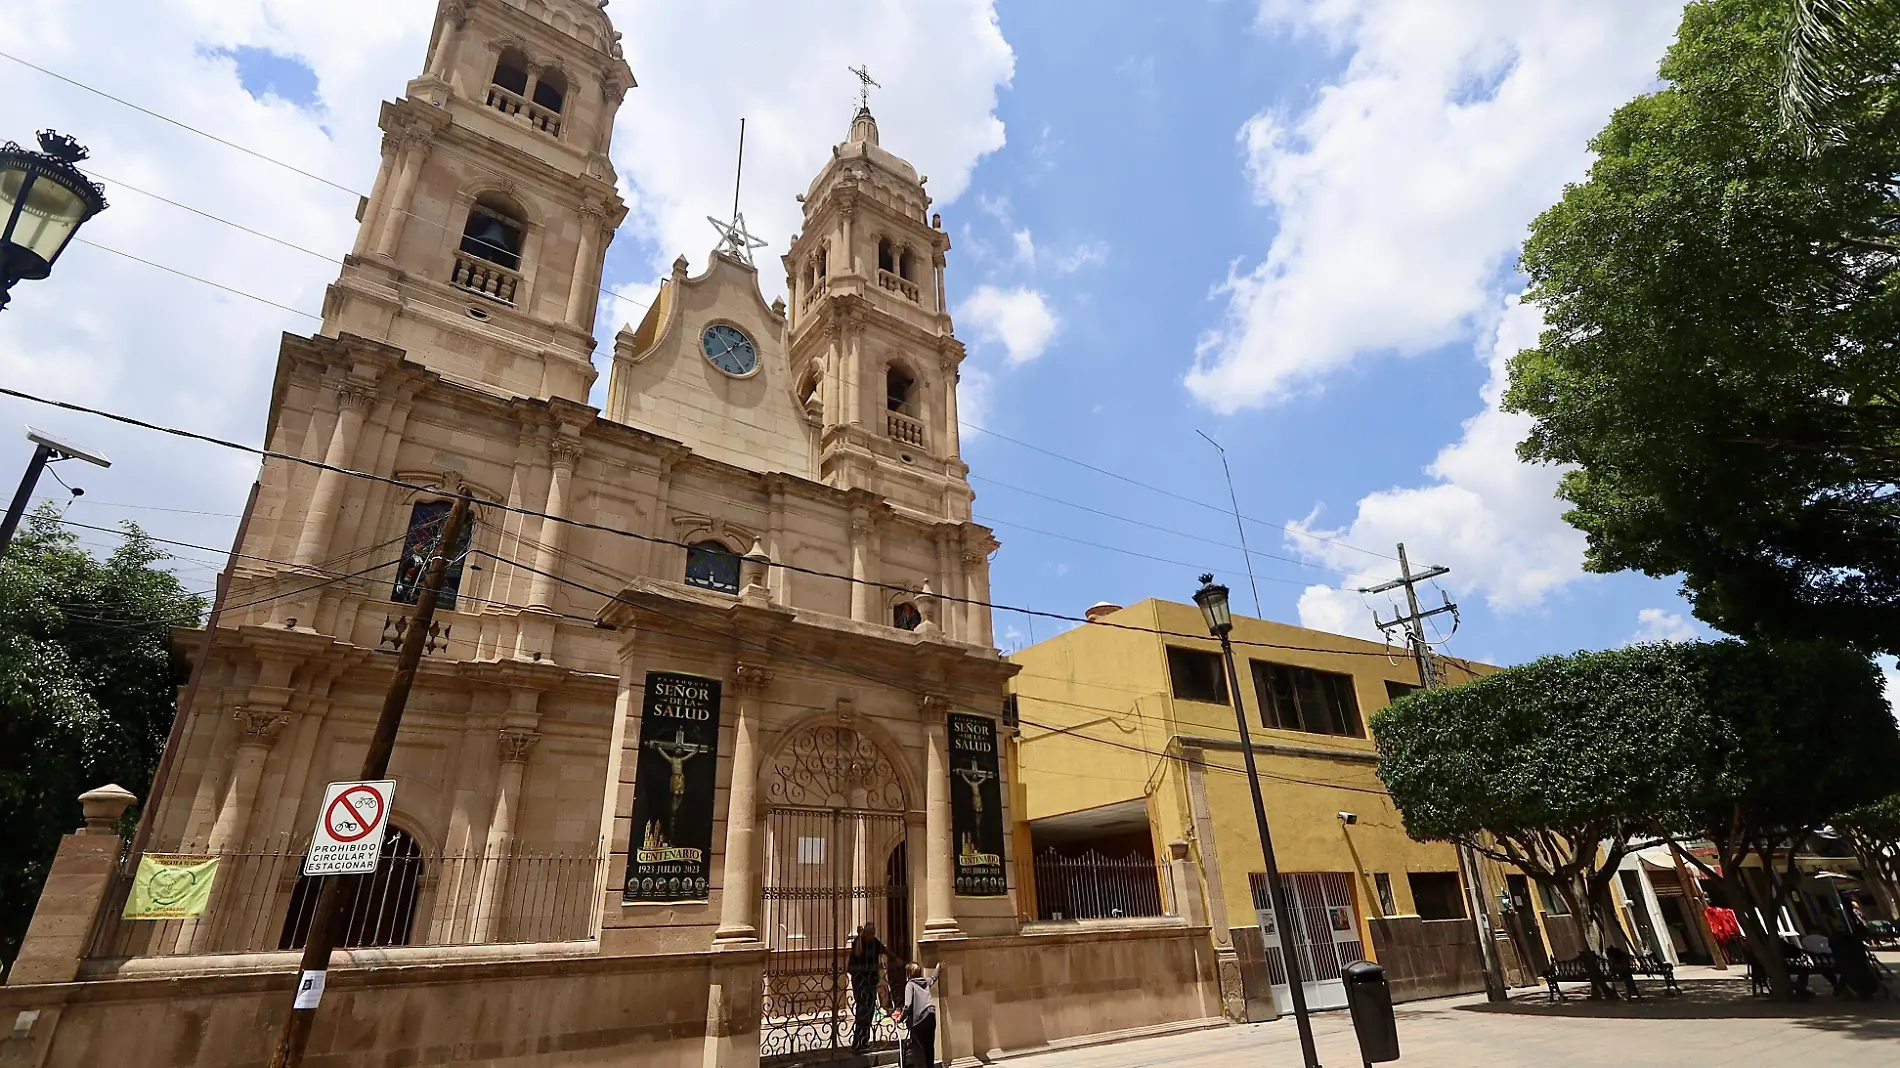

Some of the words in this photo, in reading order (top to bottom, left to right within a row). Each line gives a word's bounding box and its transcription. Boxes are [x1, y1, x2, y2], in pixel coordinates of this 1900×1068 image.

[655, 683, 709, 701] SEÑOR
[684, 699, 696, 707] LA
[653, 704, 710, 721] SALUD
[954, 722, 989, 736] SEÑOR
[955, 739, 991, 752] SALUD
[314, 844, 376, 852] PROHIBIDO
[312, 853, 365, 862] CIRCULAR
[638, 849, 700, 862] CENTENARIO
[961, 855, 998, 864] CENTENARIO
[308, 861, 374, 870] ESTACIONAR
[638, 865, 655, 874] 1923
[656, 865, 681, 875] JULIO
[683, 865, 700, 874] 2023
